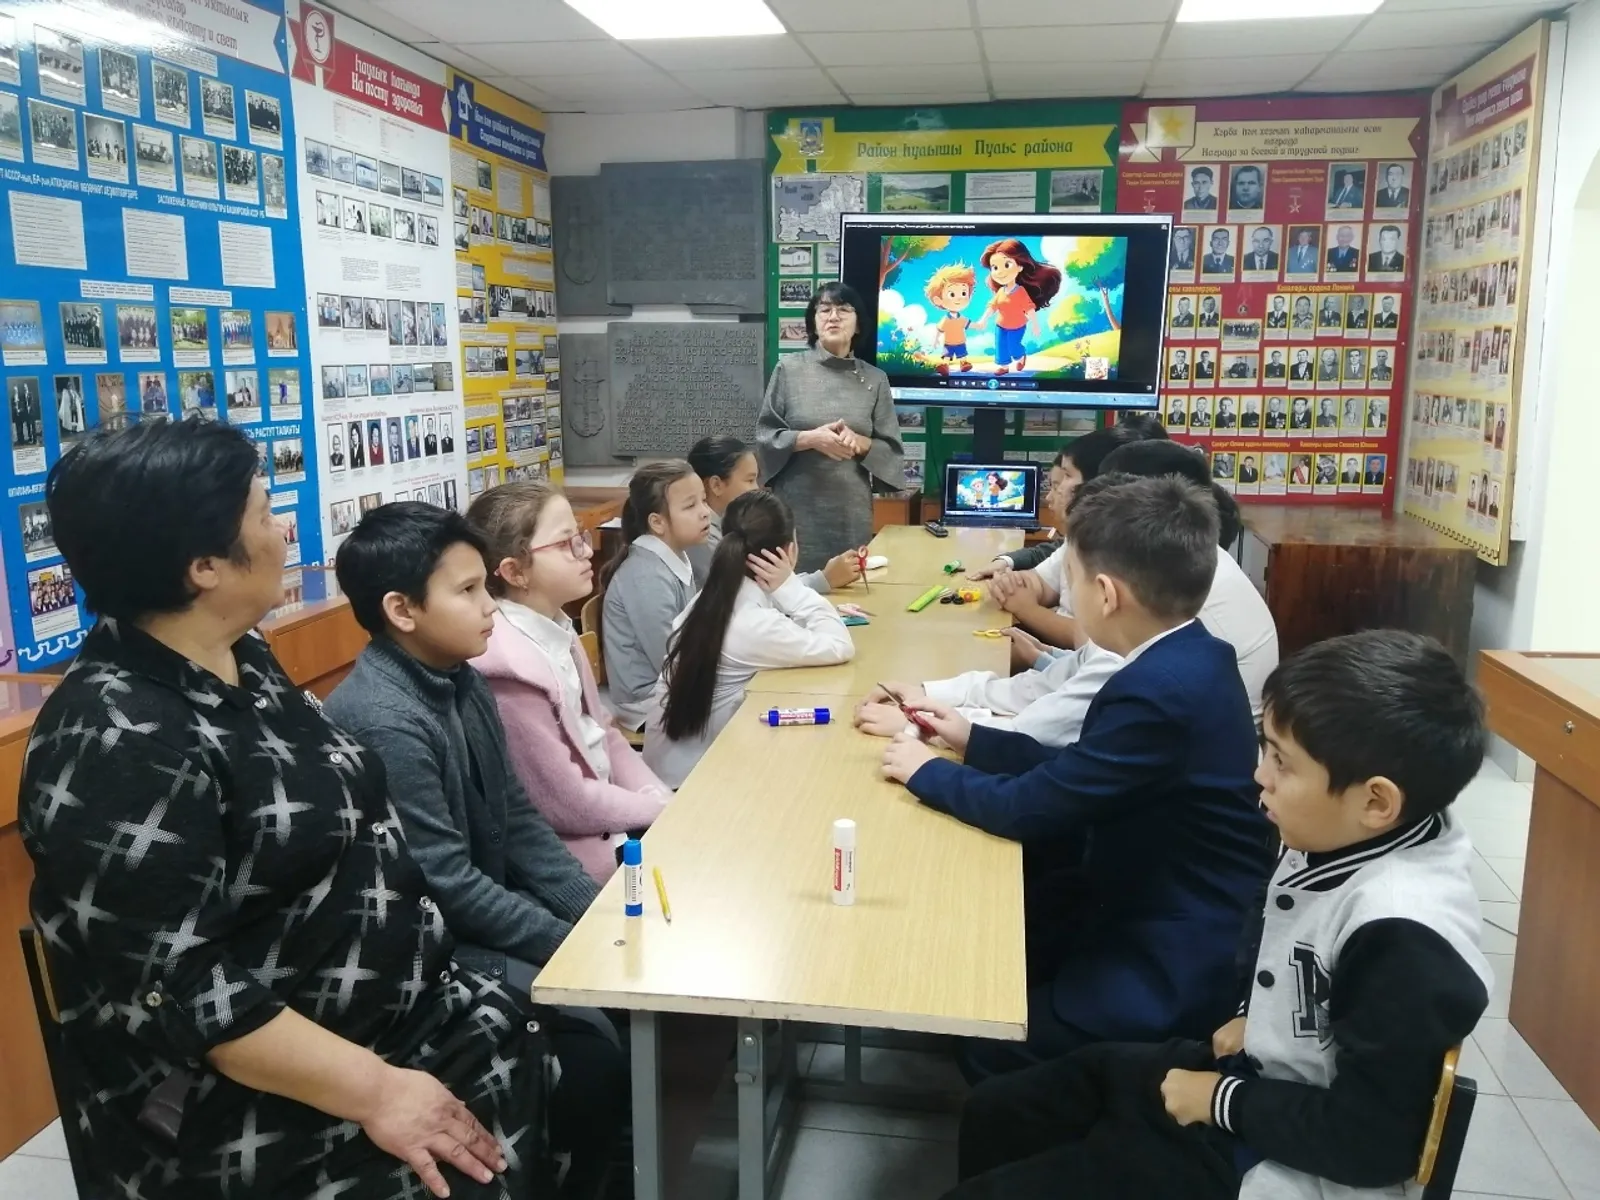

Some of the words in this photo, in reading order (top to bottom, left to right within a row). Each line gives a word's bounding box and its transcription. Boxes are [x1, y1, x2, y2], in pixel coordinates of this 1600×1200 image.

[216, 32, 238, 50] свет
[351, 71, 364, 93] На
[365, 81, 389, 106] посту
[391, 92, 424, 117] здоровья
[857, 142, 897, 157] Район
[975, 139, 1017, 158] Пульс
[1024, 138, 1073, 157] района
[1202, 147, 1237, 158] Награда
[1331, 283, 1355, 291] Ленина
[255, 426, 275, 437] РАСТУТ
